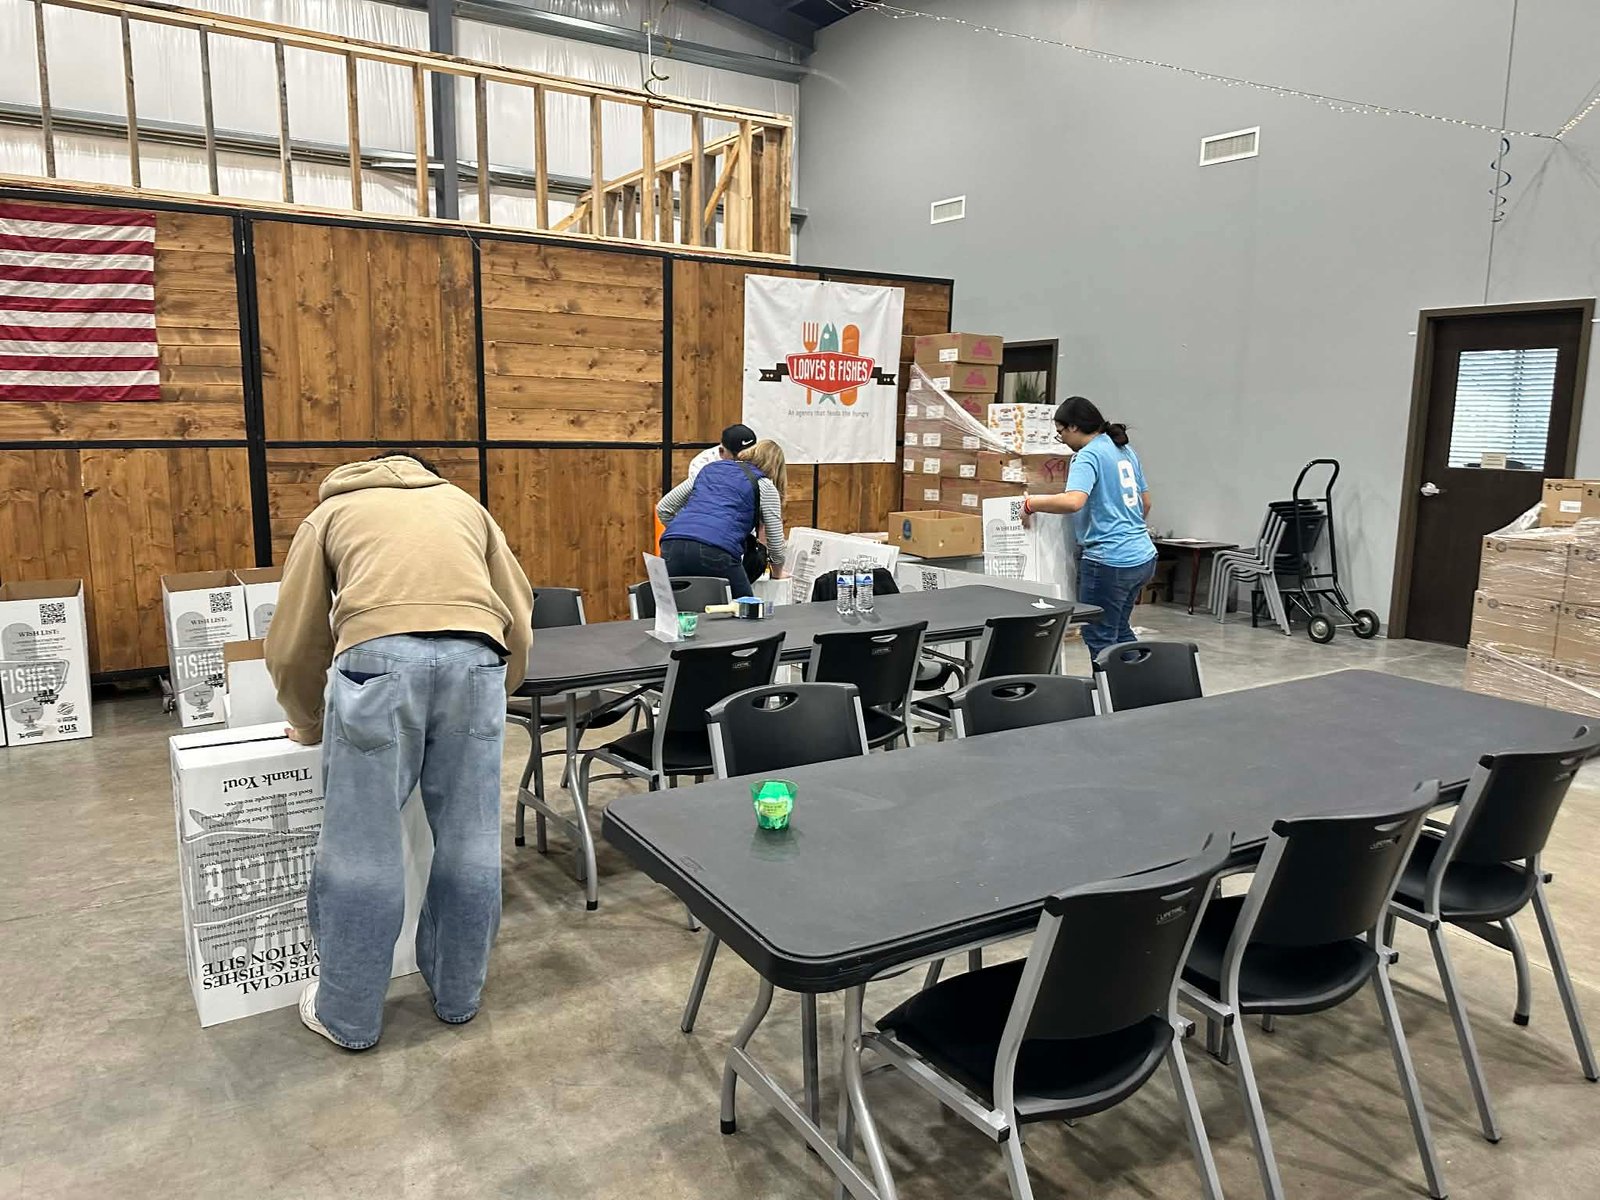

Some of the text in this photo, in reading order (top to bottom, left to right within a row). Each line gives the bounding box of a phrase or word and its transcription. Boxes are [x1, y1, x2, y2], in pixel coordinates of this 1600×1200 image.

[793, 359, 868, 382] LOAVES & FISHES
[1117, 459, 1138, 507] 9
[223, 767, 312, 792] Thank You!
[254, 793, 275, 803] people
[299, 788, 312, 796] food
[235, 818, 250, 826] local
[252, 815, 268, 824] other
[202, 939, 314, 977] ATION SITE
[203, 952, 320, 990] VES & FISHES
